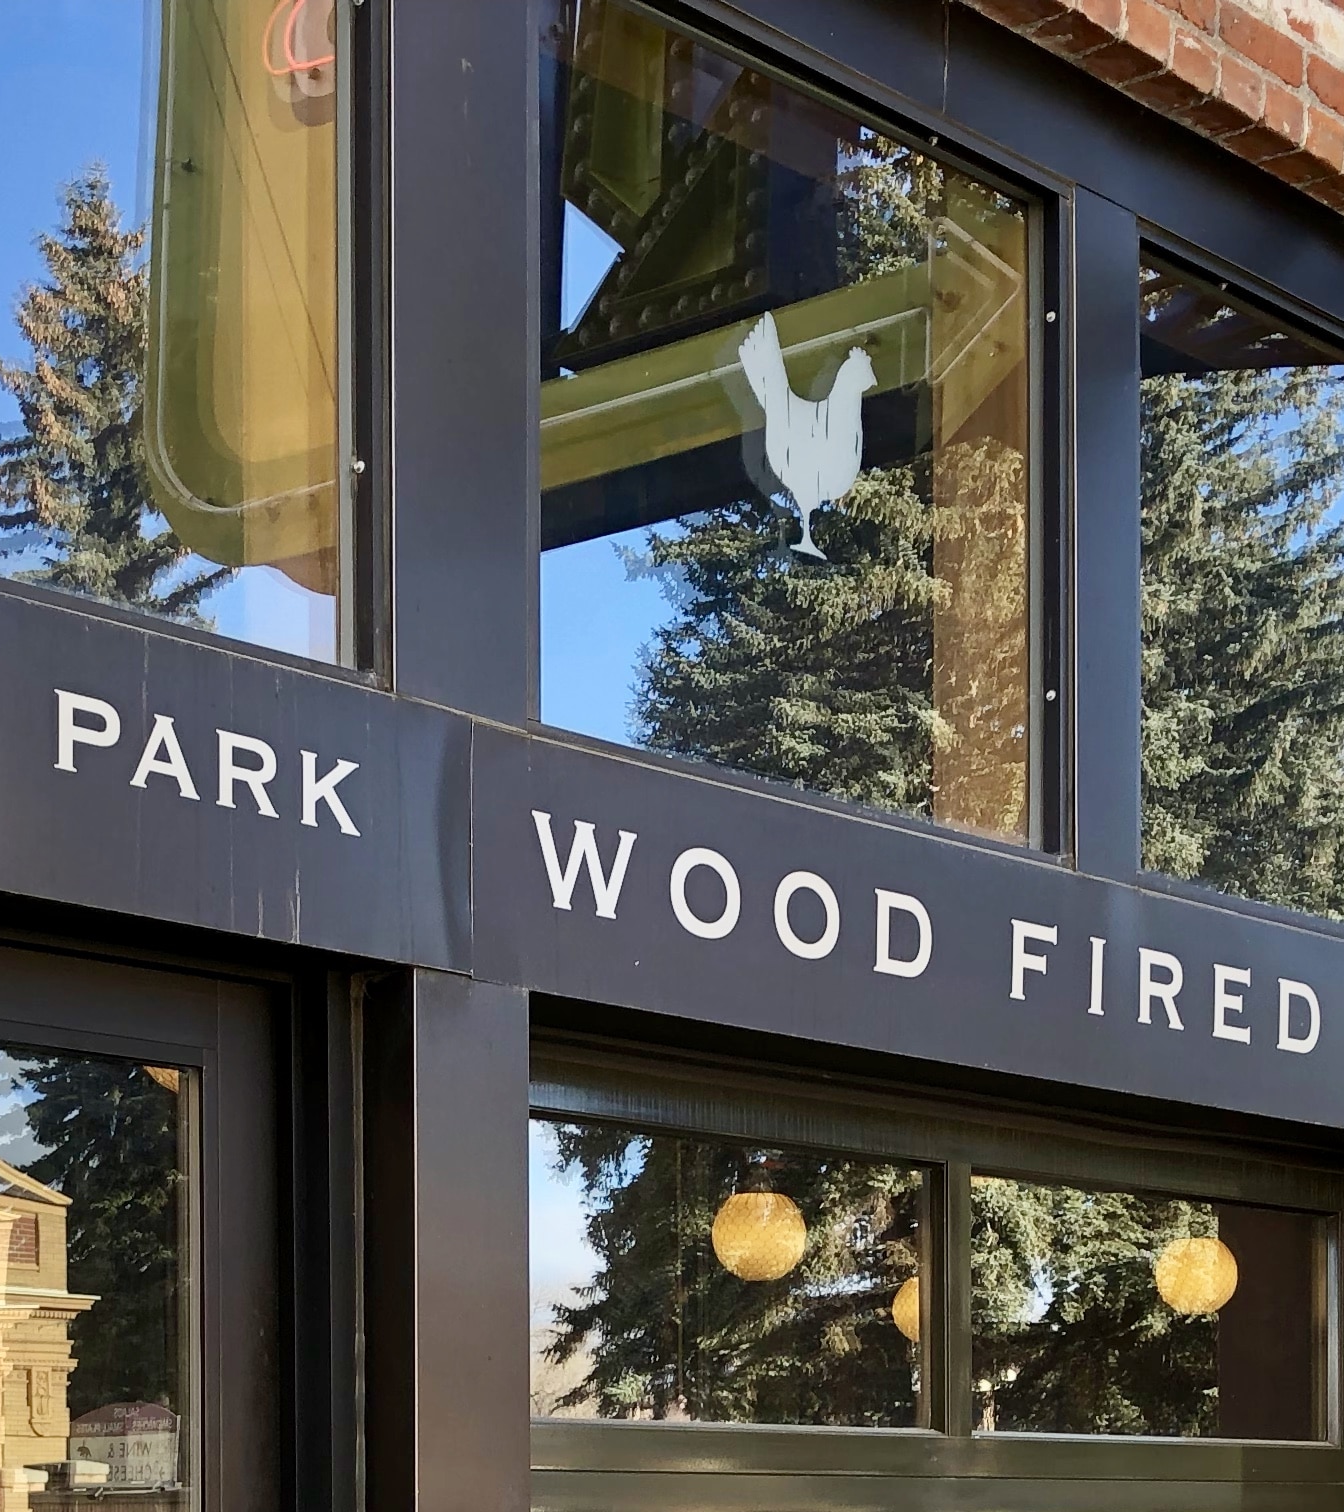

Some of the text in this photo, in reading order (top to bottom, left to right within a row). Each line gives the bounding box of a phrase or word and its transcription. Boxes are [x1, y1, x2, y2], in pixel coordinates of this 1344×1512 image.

[53, 688, 361, 837] PARK
[531, 809, 933, 978] WOOD
[1009, 918, 1321, 1054] FIRED
